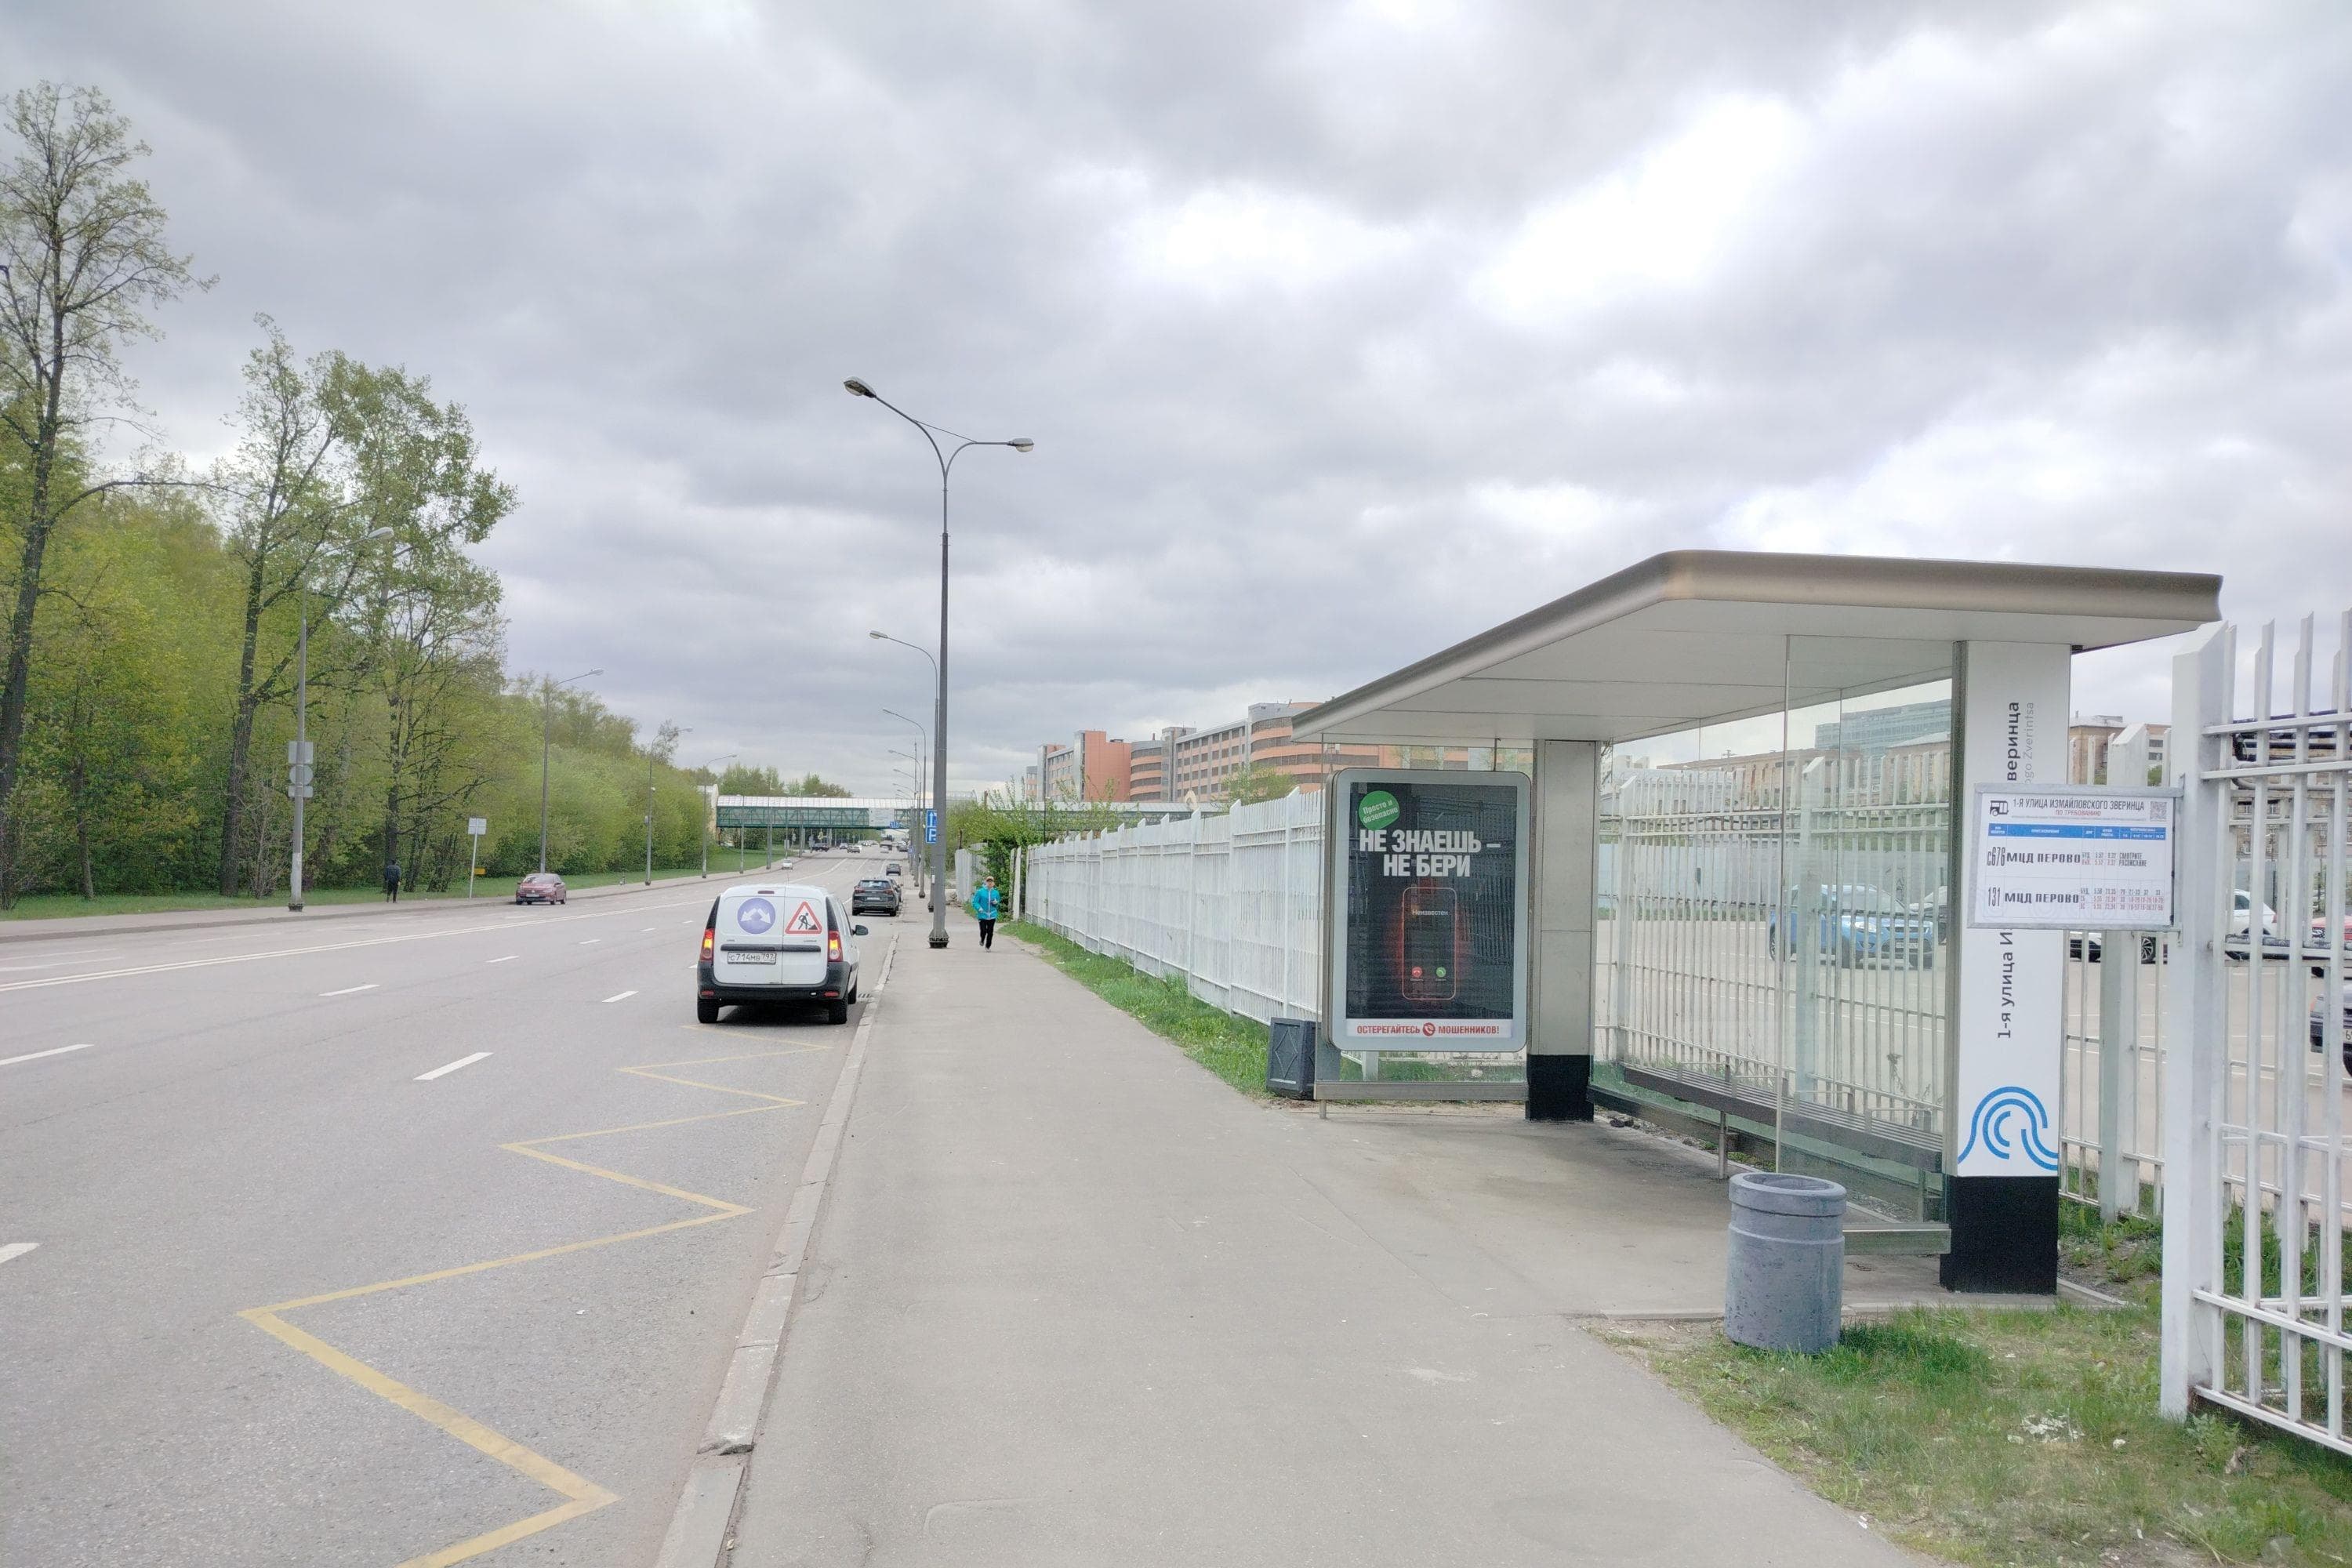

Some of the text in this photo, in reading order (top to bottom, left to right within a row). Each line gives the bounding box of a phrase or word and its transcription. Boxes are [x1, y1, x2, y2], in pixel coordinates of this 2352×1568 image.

[2024, 702, 2034, 760] Zverintsa
[1363, 802, 1387, 815] Просто
[2013, 798, 2144, 811] 1-Я УЛИЦА ИЗМАЙЛОВСКОГО ЗВЕРИНЦА
[1363, 807, 1399, 824] безопасно
[1359, 829, 1387, 852] НЕ
[1392, 829, 1482, 853] ЗНАЕШЬ
[1383, 854, 1471, 877] НЕ БЕРИ
[2006, 852, 2034, 864] МЦД
[2037, 853, 2081, 863] ПЕРОВО
[1998, 702, 2020, 1039] 1-я улица И веринца
[1987, 887, 2001, 907] 131
[2004, 892, 2079, 904] МЦД ПЕРОВО
[1356, 1024, 1500, 1034] ОСТЕРЕГАЙТЕСЬ МОШЕННИКОВ!
